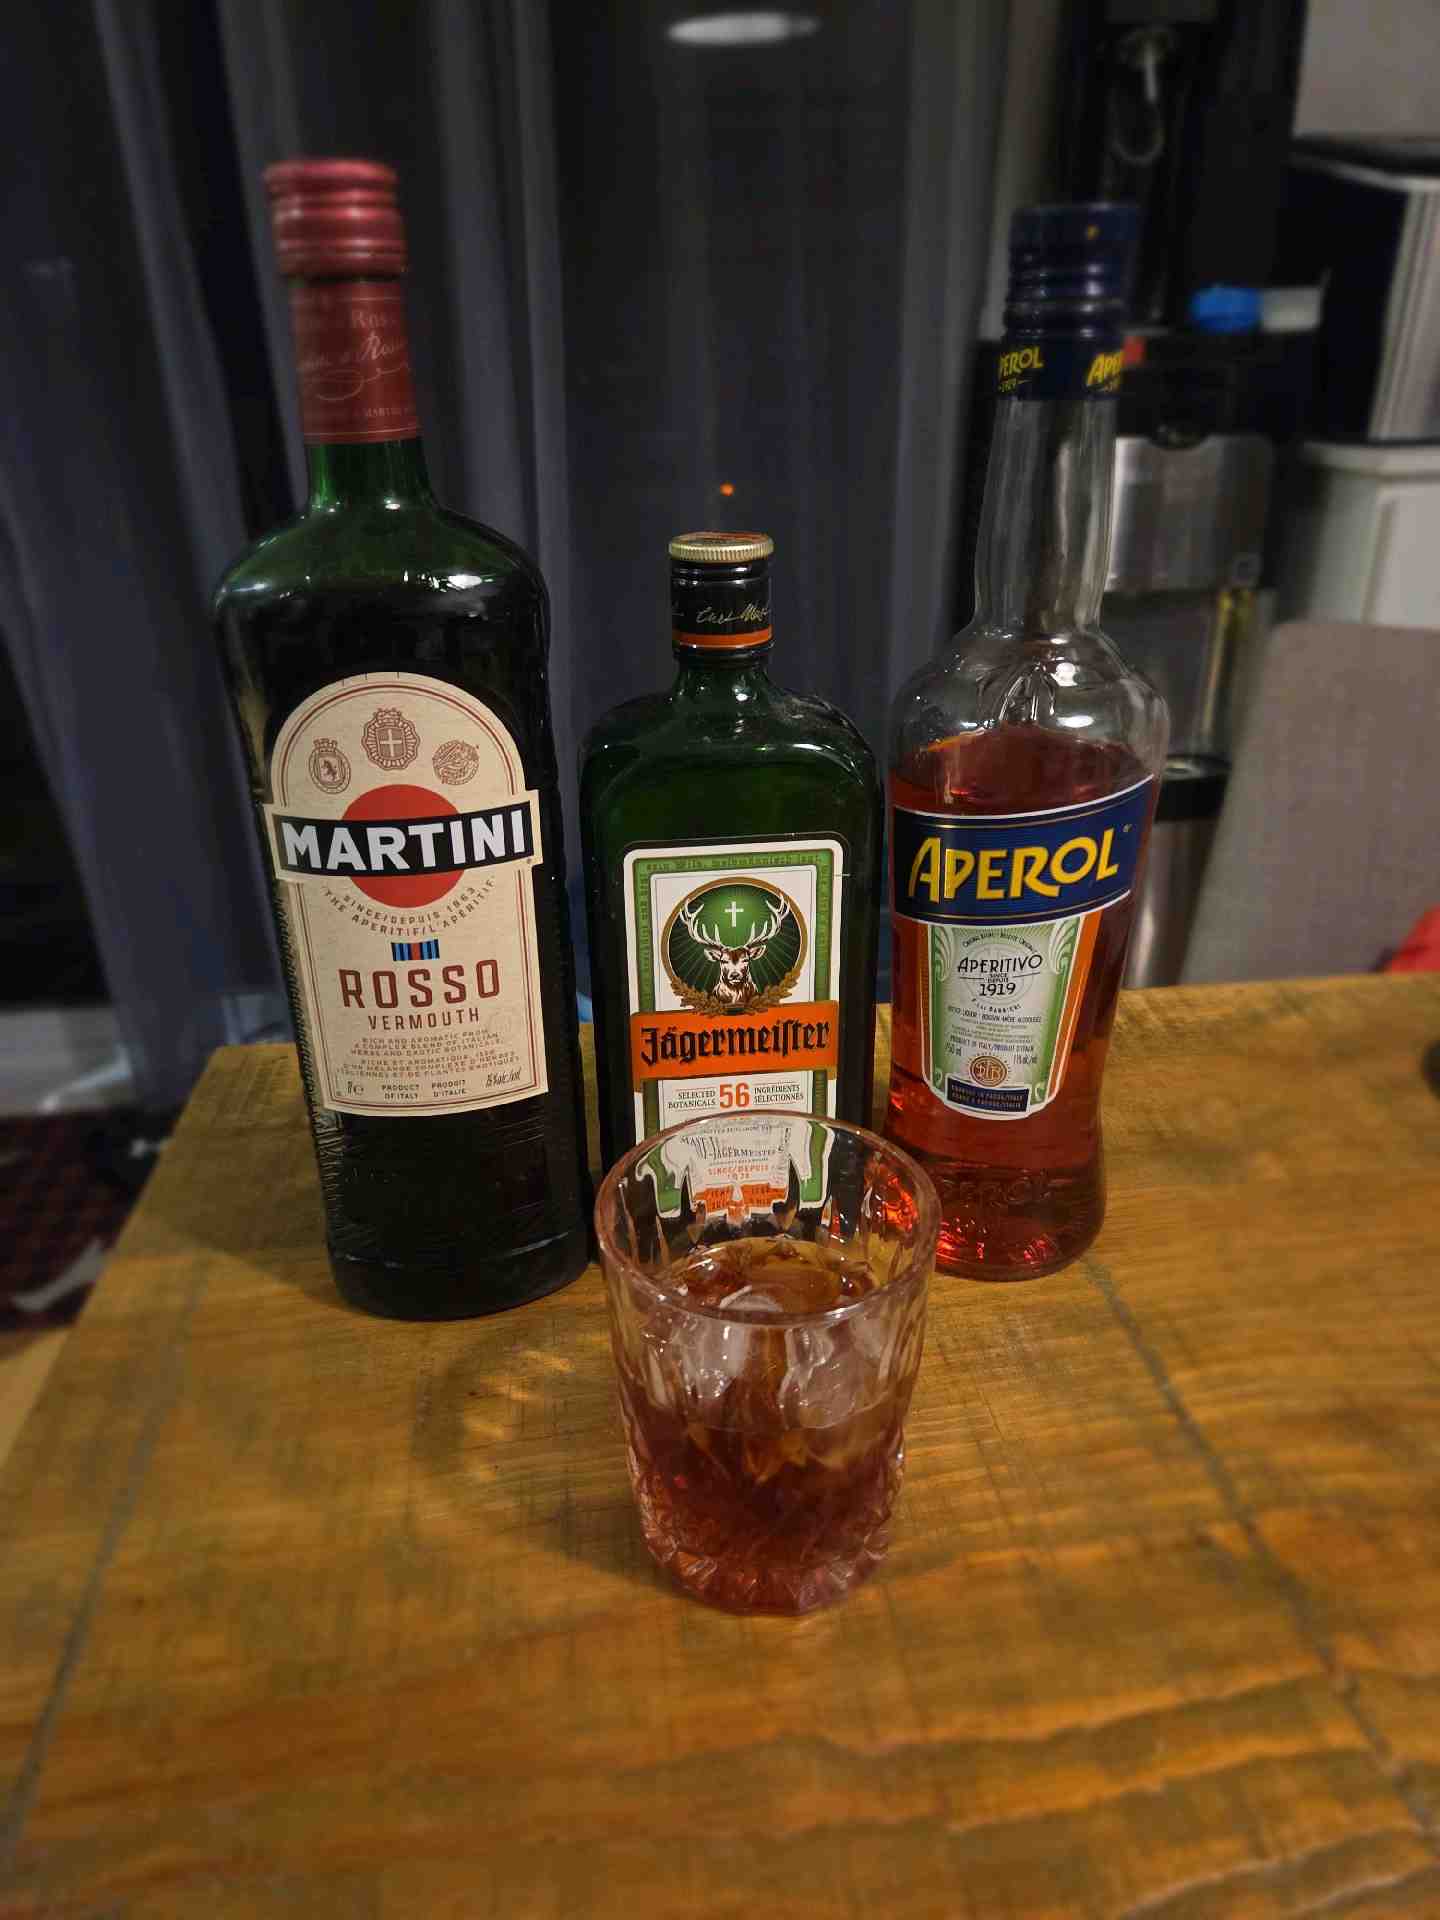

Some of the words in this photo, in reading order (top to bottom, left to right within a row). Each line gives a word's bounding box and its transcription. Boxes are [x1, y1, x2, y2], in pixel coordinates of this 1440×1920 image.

[281, 809, 526, 870] MARTINI
[908, 827, 1119, 904] APEROL
[957, 954, 1043, 973] APERITIVO
[339, 959, 500, 1008] ROSSO
[979, 982, 1016, 996] 1919
[368, 1007, 480, 1031] VERMOUTH
[641, 1019, 830, 1066] Jägermeister
[669, 1099, 716, 1110] BOTANICALS
[678, 1089, 716, 1100] SELECTED
[719, 1082, 750, 1109] 56
